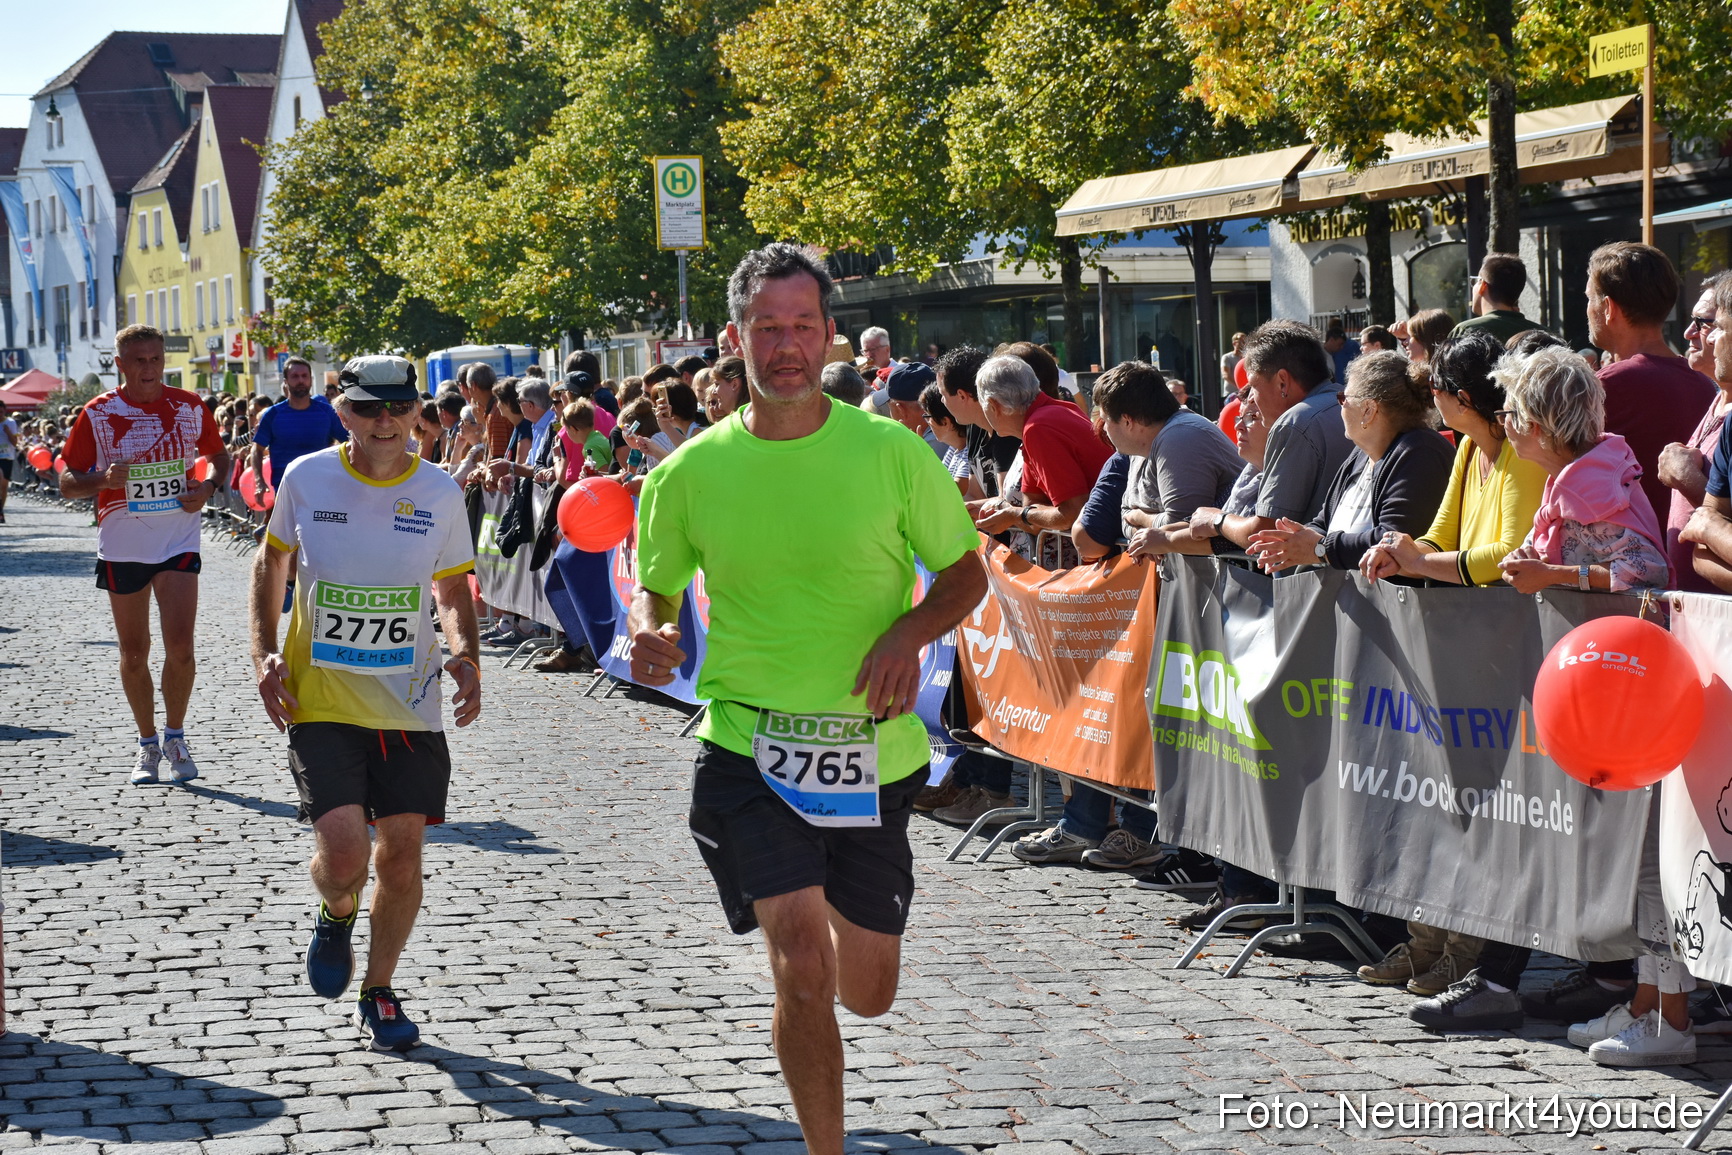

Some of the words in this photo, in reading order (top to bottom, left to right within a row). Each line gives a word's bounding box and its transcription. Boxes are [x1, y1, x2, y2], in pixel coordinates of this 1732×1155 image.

[1600, 41, 1644, 63] Toiletten
[671, 171, 688, 190] H
[148, 267, 165, 285] HOTEL
[130, 463, 181, 479] BOCK
[132, 479, 181, 499] 2139
[137, 501, 179, 511] MICHAEL
[395, 502, 415, 516] 20
[314, 511, 348, 521] BOCK
[394, 516, 435, 528] Neumarkter
[394, 525, 428, 536] Stadtlauf
[324, 586, 411, 609] BOCK
[1039, 589, 1070, 604] Neumarkts
[1070, 590, 1106, 604] moderner
[1107, 588, 1140, 602] Partner
[1048, 608, 1056, 621] die
[1056, 609, 1093, 627] Konzeption
[1095, 607, 1113, 620] und
[325, 613, 408, 645] 2776
[1052, 627, 1066, 640] Ihrer
[1066, 628, 1101, 644] Projekte
[1101, 628, 1117, 641] was
[336, 647, 405, 664] KLEMENS
[1092, 646, 1106, 660] und
[1559, 640, 1647, 670] RÖDL
[1601, 663, 1646, 678] energie
[993, 696, 1051, 734] Agentur
[768, 713, 868, 742] BOCK
[1151, 720, 1210, 753] inspired
[1211, 733, 1220, 763] by
[768, 745, 863, 786] 2765
